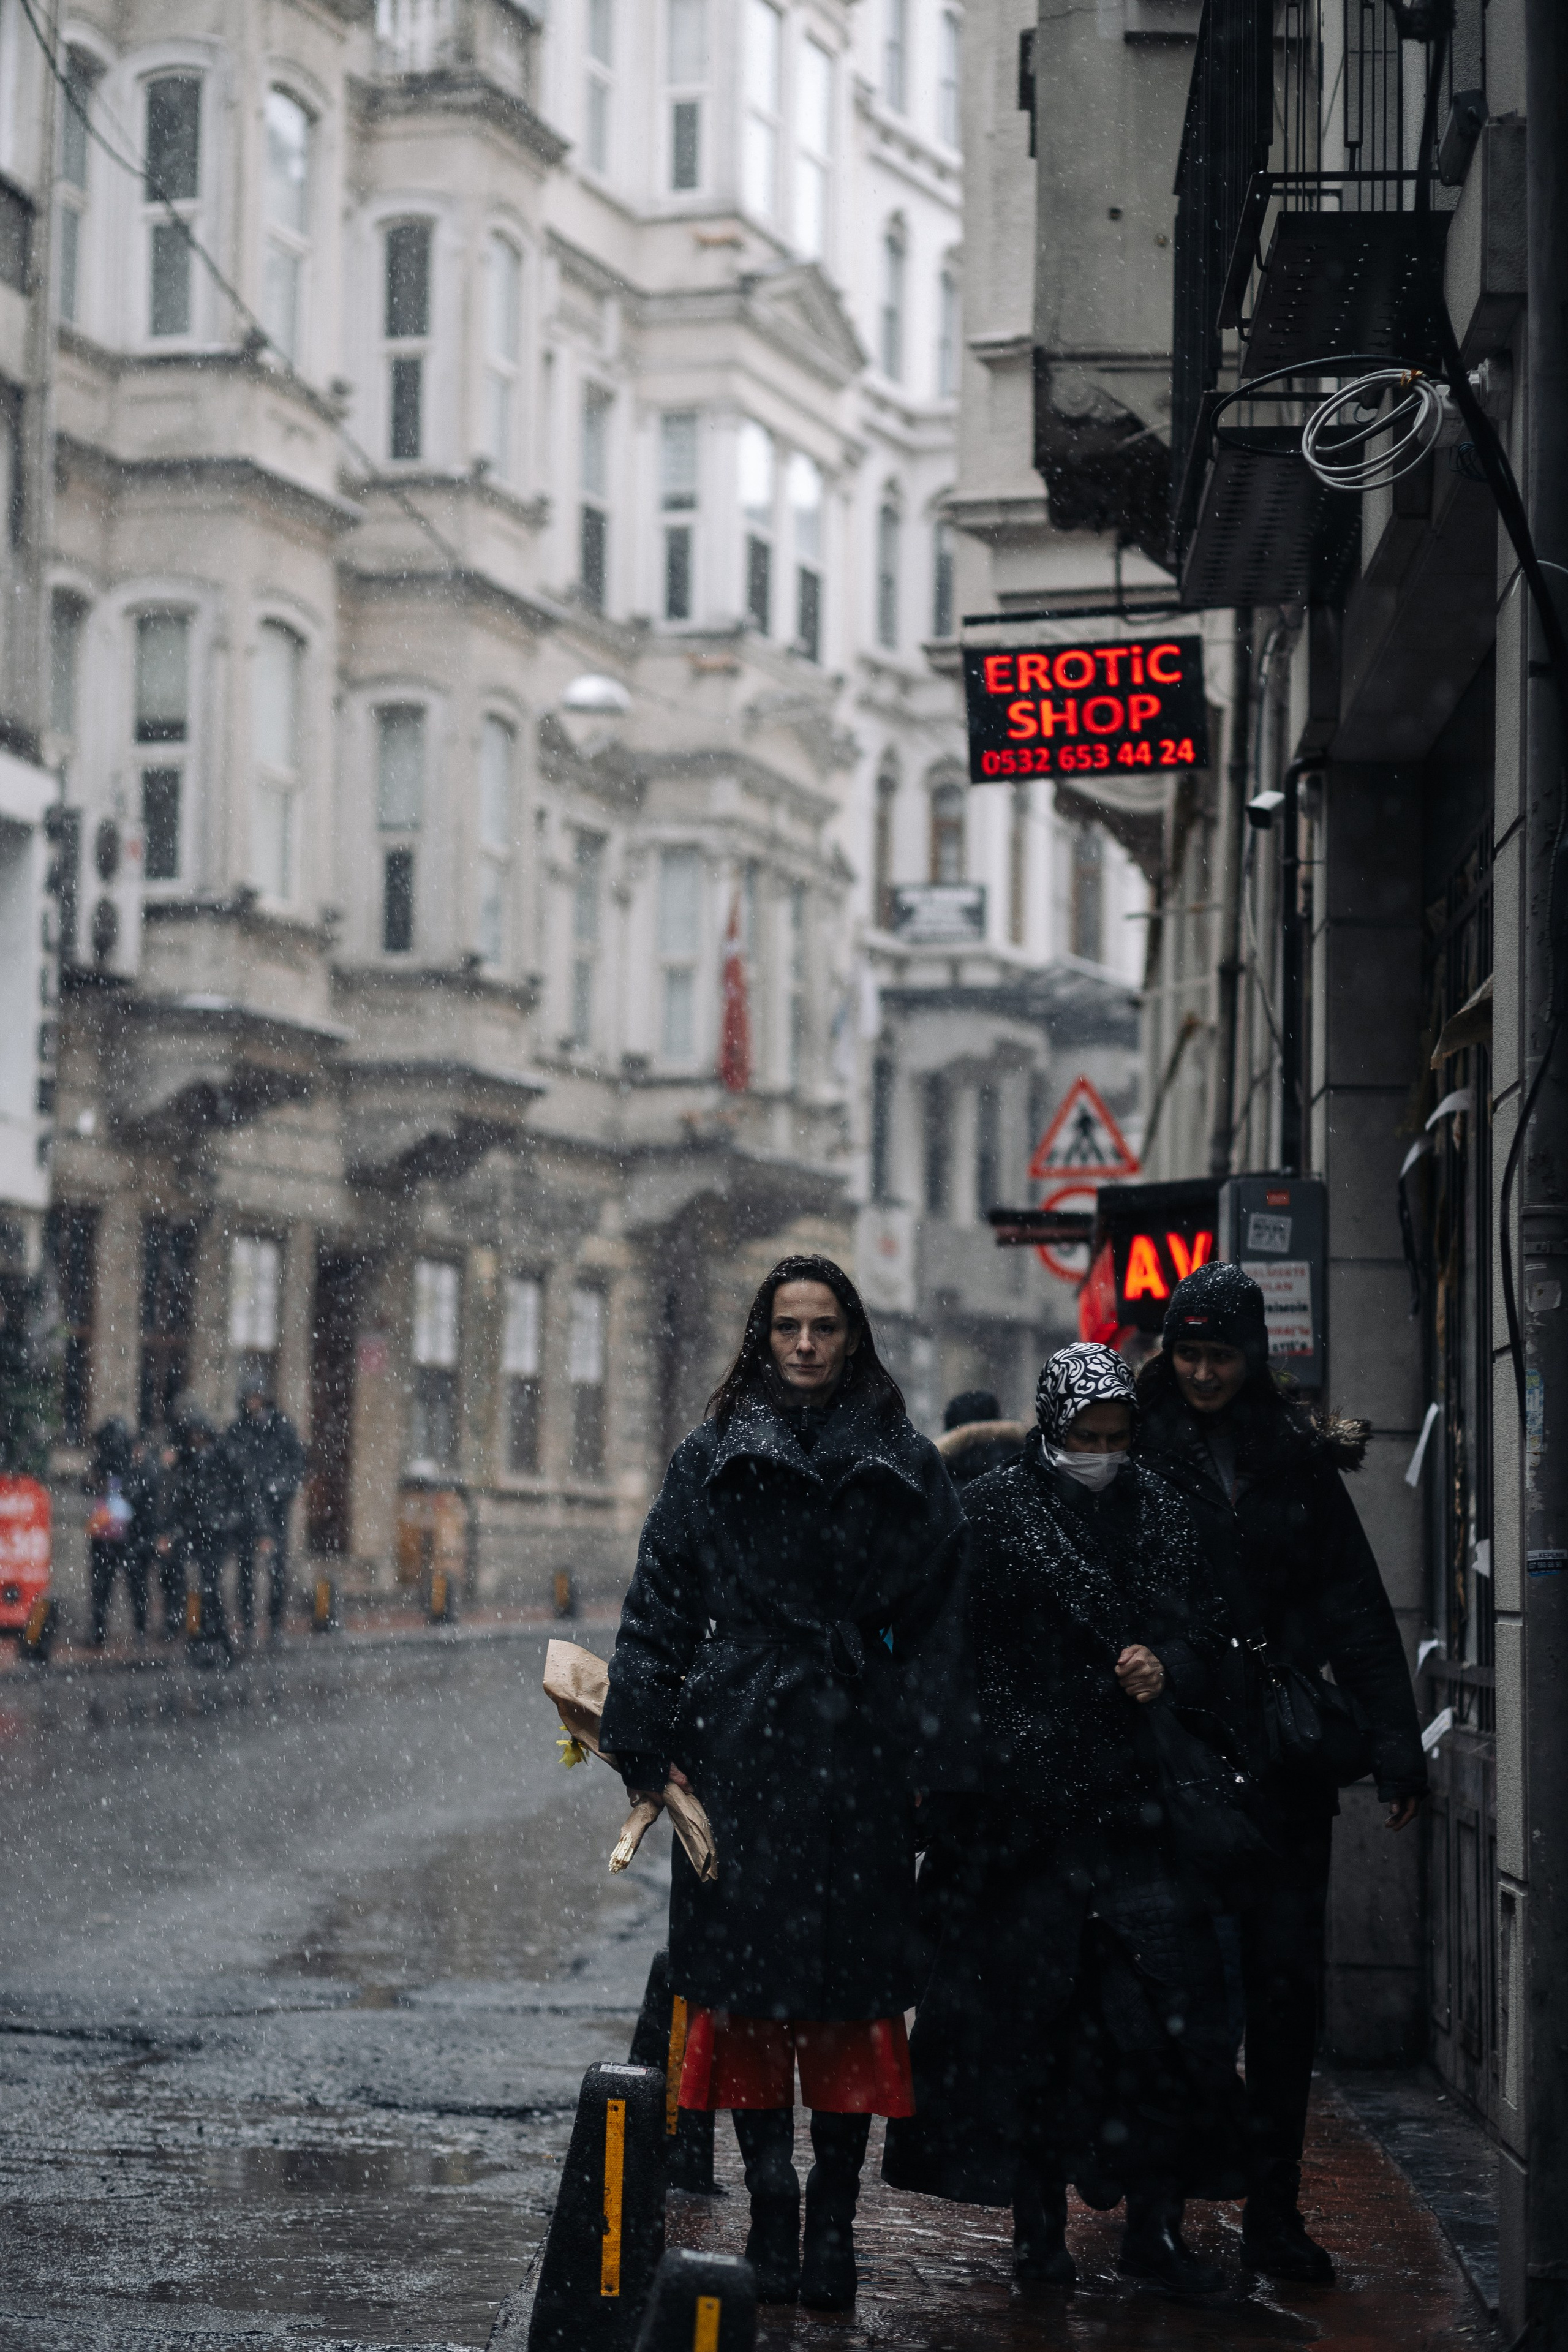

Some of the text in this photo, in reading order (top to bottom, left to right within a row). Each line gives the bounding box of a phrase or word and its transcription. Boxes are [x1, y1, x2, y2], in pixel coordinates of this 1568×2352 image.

[1006, 693, 1162, 740] SHOP
[981, 738, 1196, 774] 0532 653 44 24
